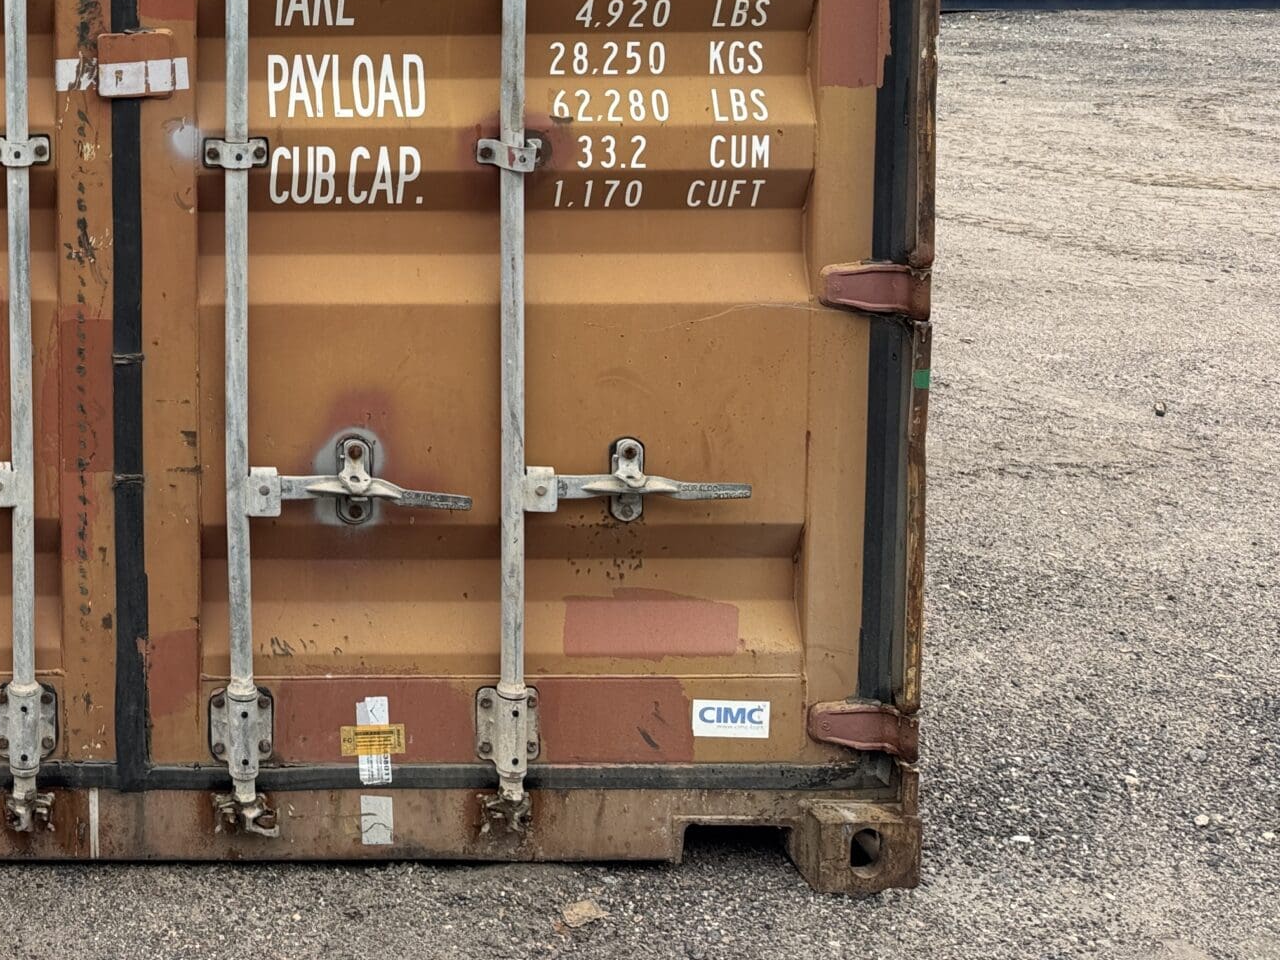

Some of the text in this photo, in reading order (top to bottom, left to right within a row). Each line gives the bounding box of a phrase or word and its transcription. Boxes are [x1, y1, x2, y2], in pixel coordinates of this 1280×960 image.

[549, 40, 764, 76] 28,250 KGS
[267, 53, 426, 118] PAYLOAD
[552, 88, 769, 124] 62,280 LBS
[577, 135, 770, 170] 33.2 CUM
[553, 179, 767, 209] 1,170 CUFT
[698, 706, 764, 725] CIMC
